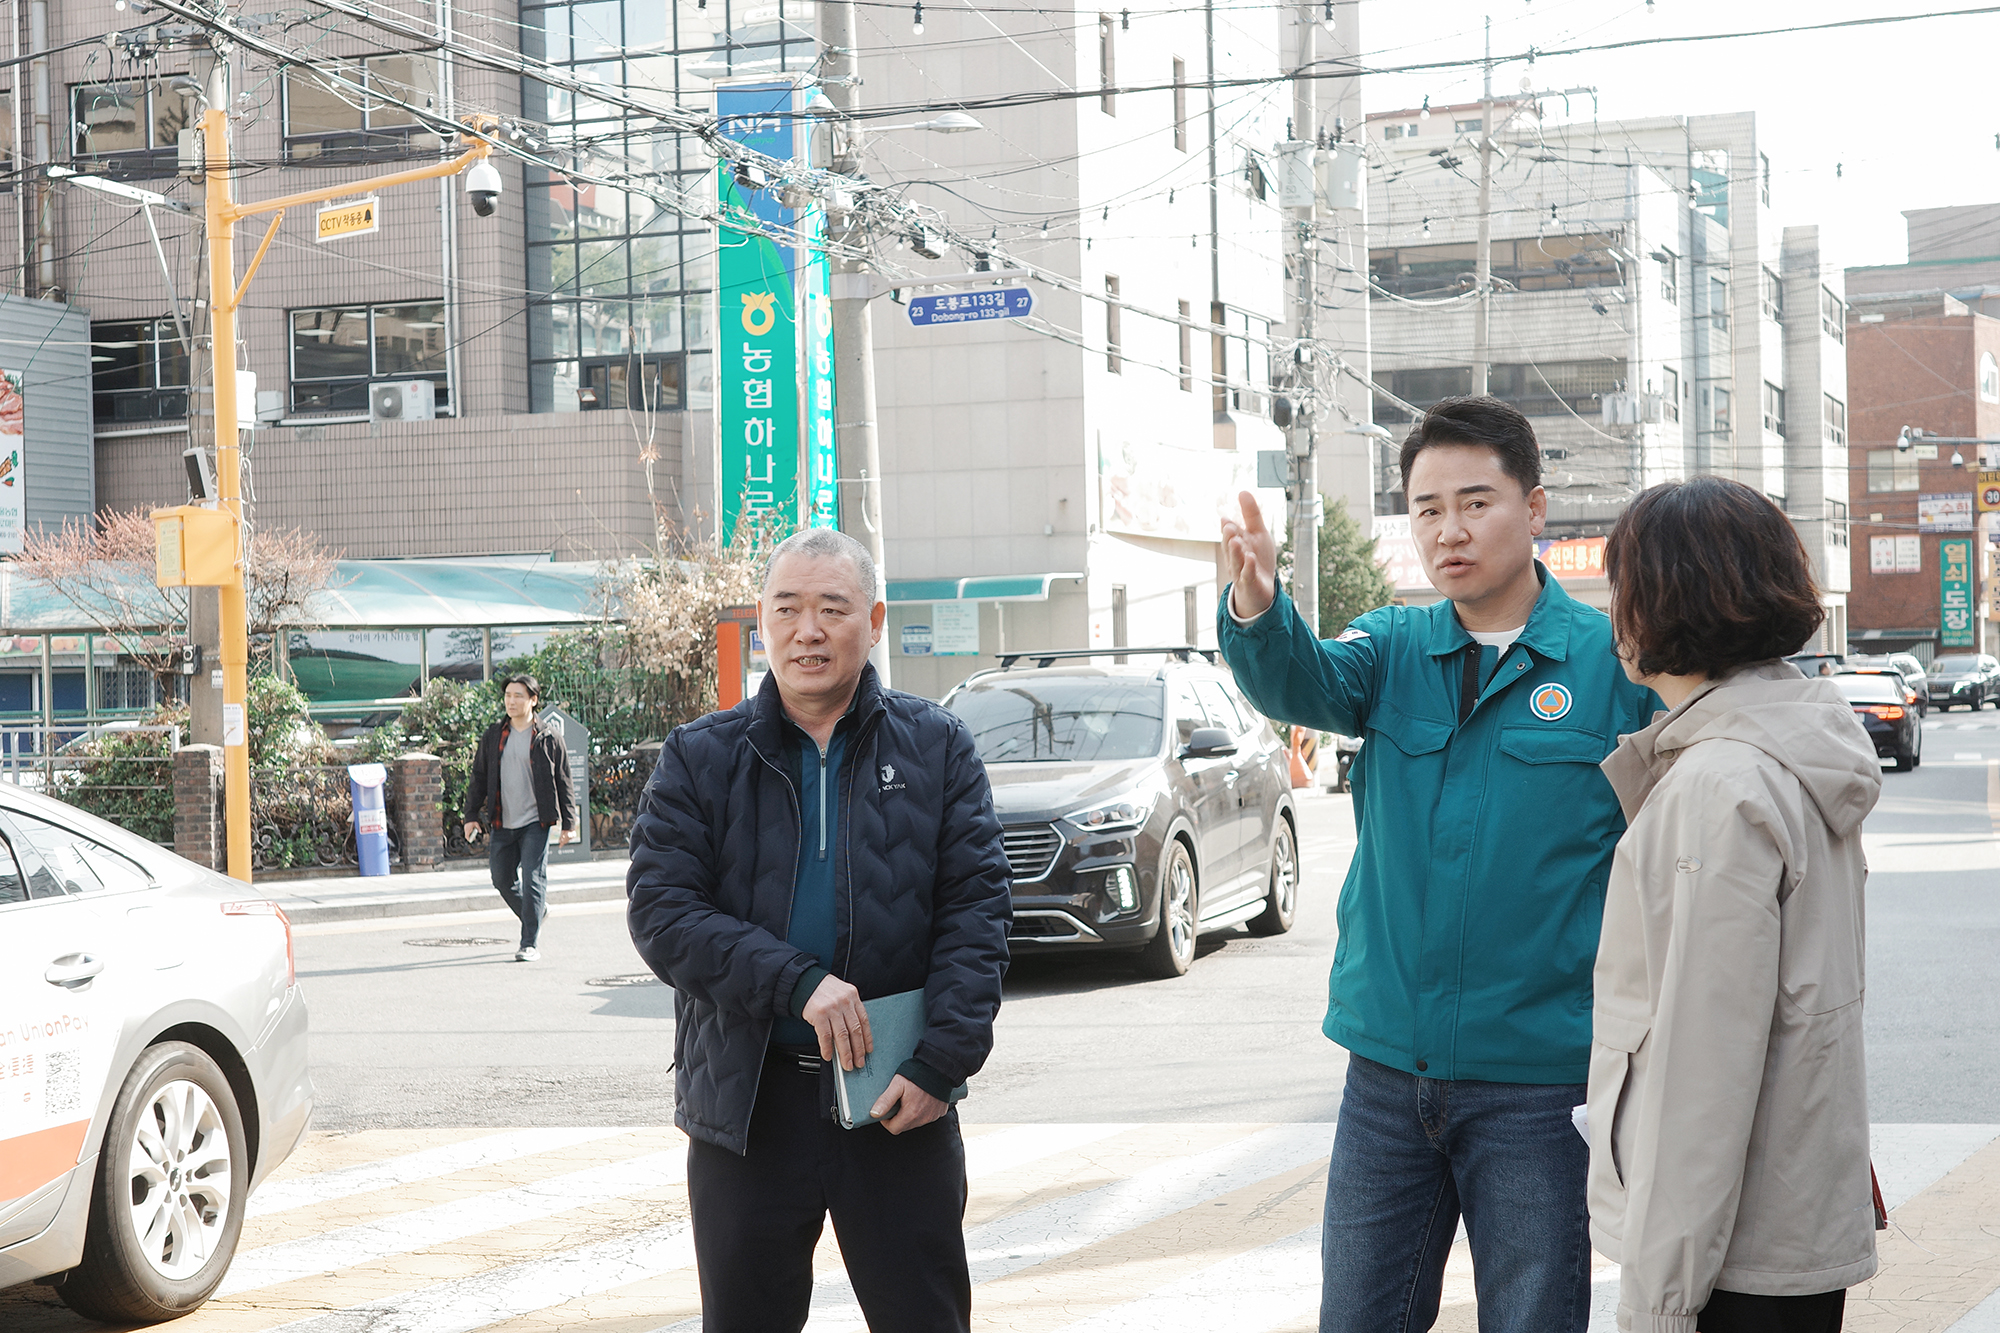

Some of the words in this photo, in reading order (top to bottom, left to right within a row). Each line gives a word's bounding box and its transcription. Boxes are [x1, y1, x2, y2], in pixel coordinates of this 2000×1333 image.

[728, 110, 781, 135] NH
[320, 216, 342, 231] CCTV
[342, 211, 362, 227] 작동중
[934, 292, 1005, 310] 도봉로133길
[1016, 297, 1029, 307] 27
[911, 306, 924, 317] 23
[931, 312, 979, 323] Dobong-ro
[980, 307, 1010, 319] 133-gil
[815, 341, 834, 531] 농협하나로
[1986, 490, 2000, 504] 30
[1548, 544, 1602, 571] 전면통제
[348, 632, 370, 643] 같이의
[373, 632, 388, 642] 가치
[391, 632, 419, 642] NH농협
[20, 1014, 89, 1041] UnionPay
